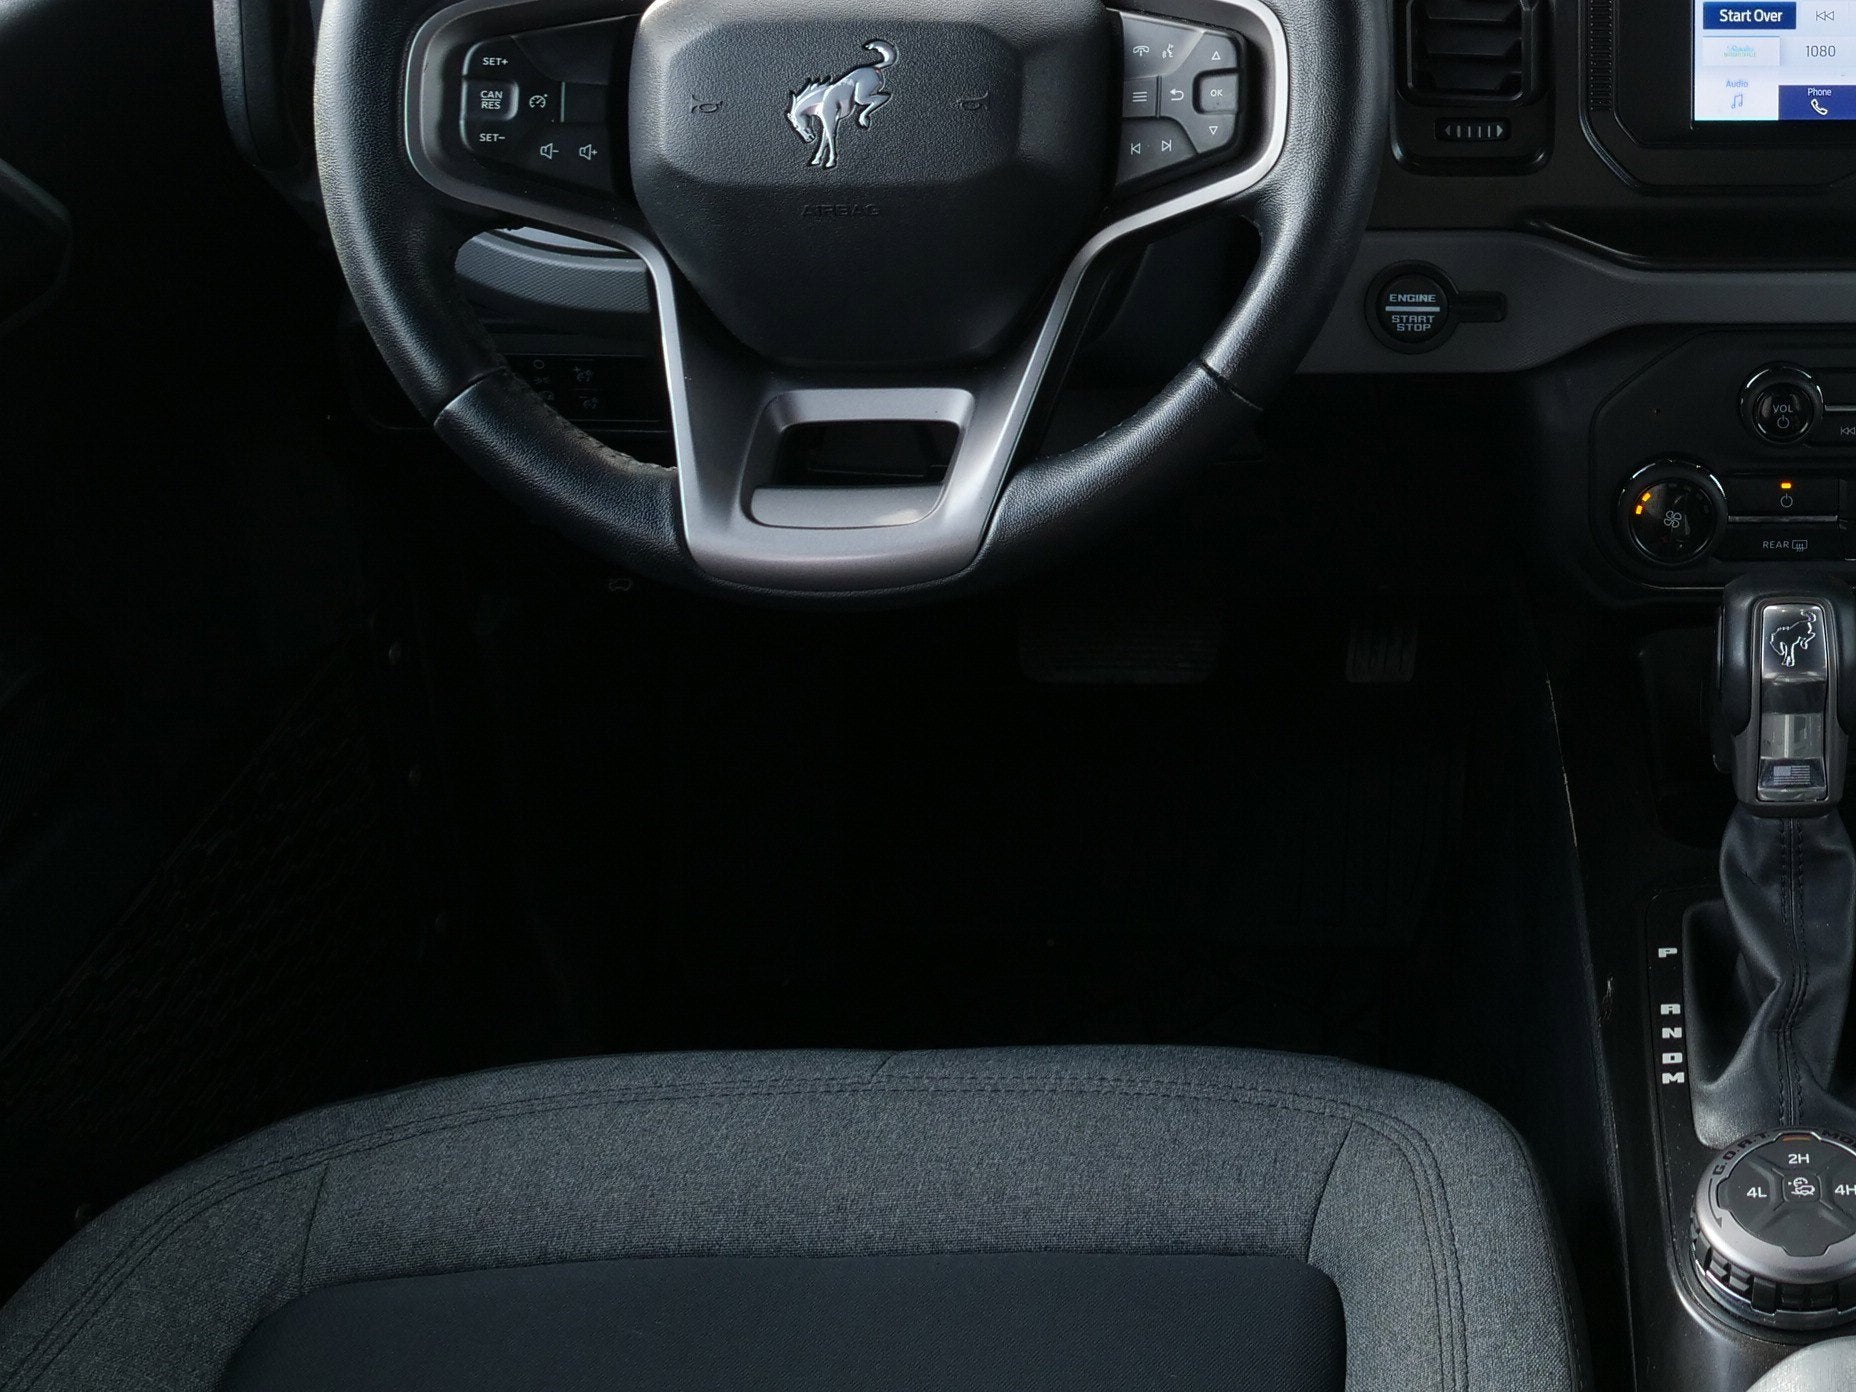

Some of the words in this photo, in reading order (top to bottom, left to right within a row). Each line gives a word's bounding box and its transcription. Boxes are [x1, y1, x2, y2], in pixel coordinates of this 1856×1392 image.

[1719, 8, 1750, 23] Start
[1752, 9, 1783, 23] Over
[1805, 44, 1836, 58] 1080
[481, 56, 509, 67] SET+
[1725, 80, 1748, 89] Audio
[479, 89, 504, 100] CAN
[1209, 88, 1224, 98] OK
[1807, 87, 1832, 97] Phone
[480, 100, 503, 111] RES
[478, 132, 506, 143] SET-
[800, 202, 882, 218] AIRBAG
[1389, 293, 1437, 303] ENGINE
[1391, 315, 1436, 324] START
[1396, 323, 1431, 332] STOP
[1772, 404, 1794, 414] VOL
[1762, 540, 1790, 549] REAR
[1657, 946, 1679, 958] P
[1660, 1003, 1681, 1016] R
[1661, 1026, 1683, 1039] N
[1662, 1052, 1683, 1064] D
[1661, 1072, 1685, 1084] M
[1788, 1154, 1810, 1165] 2H
[1747, 1186, 1768, 1199] 4L
